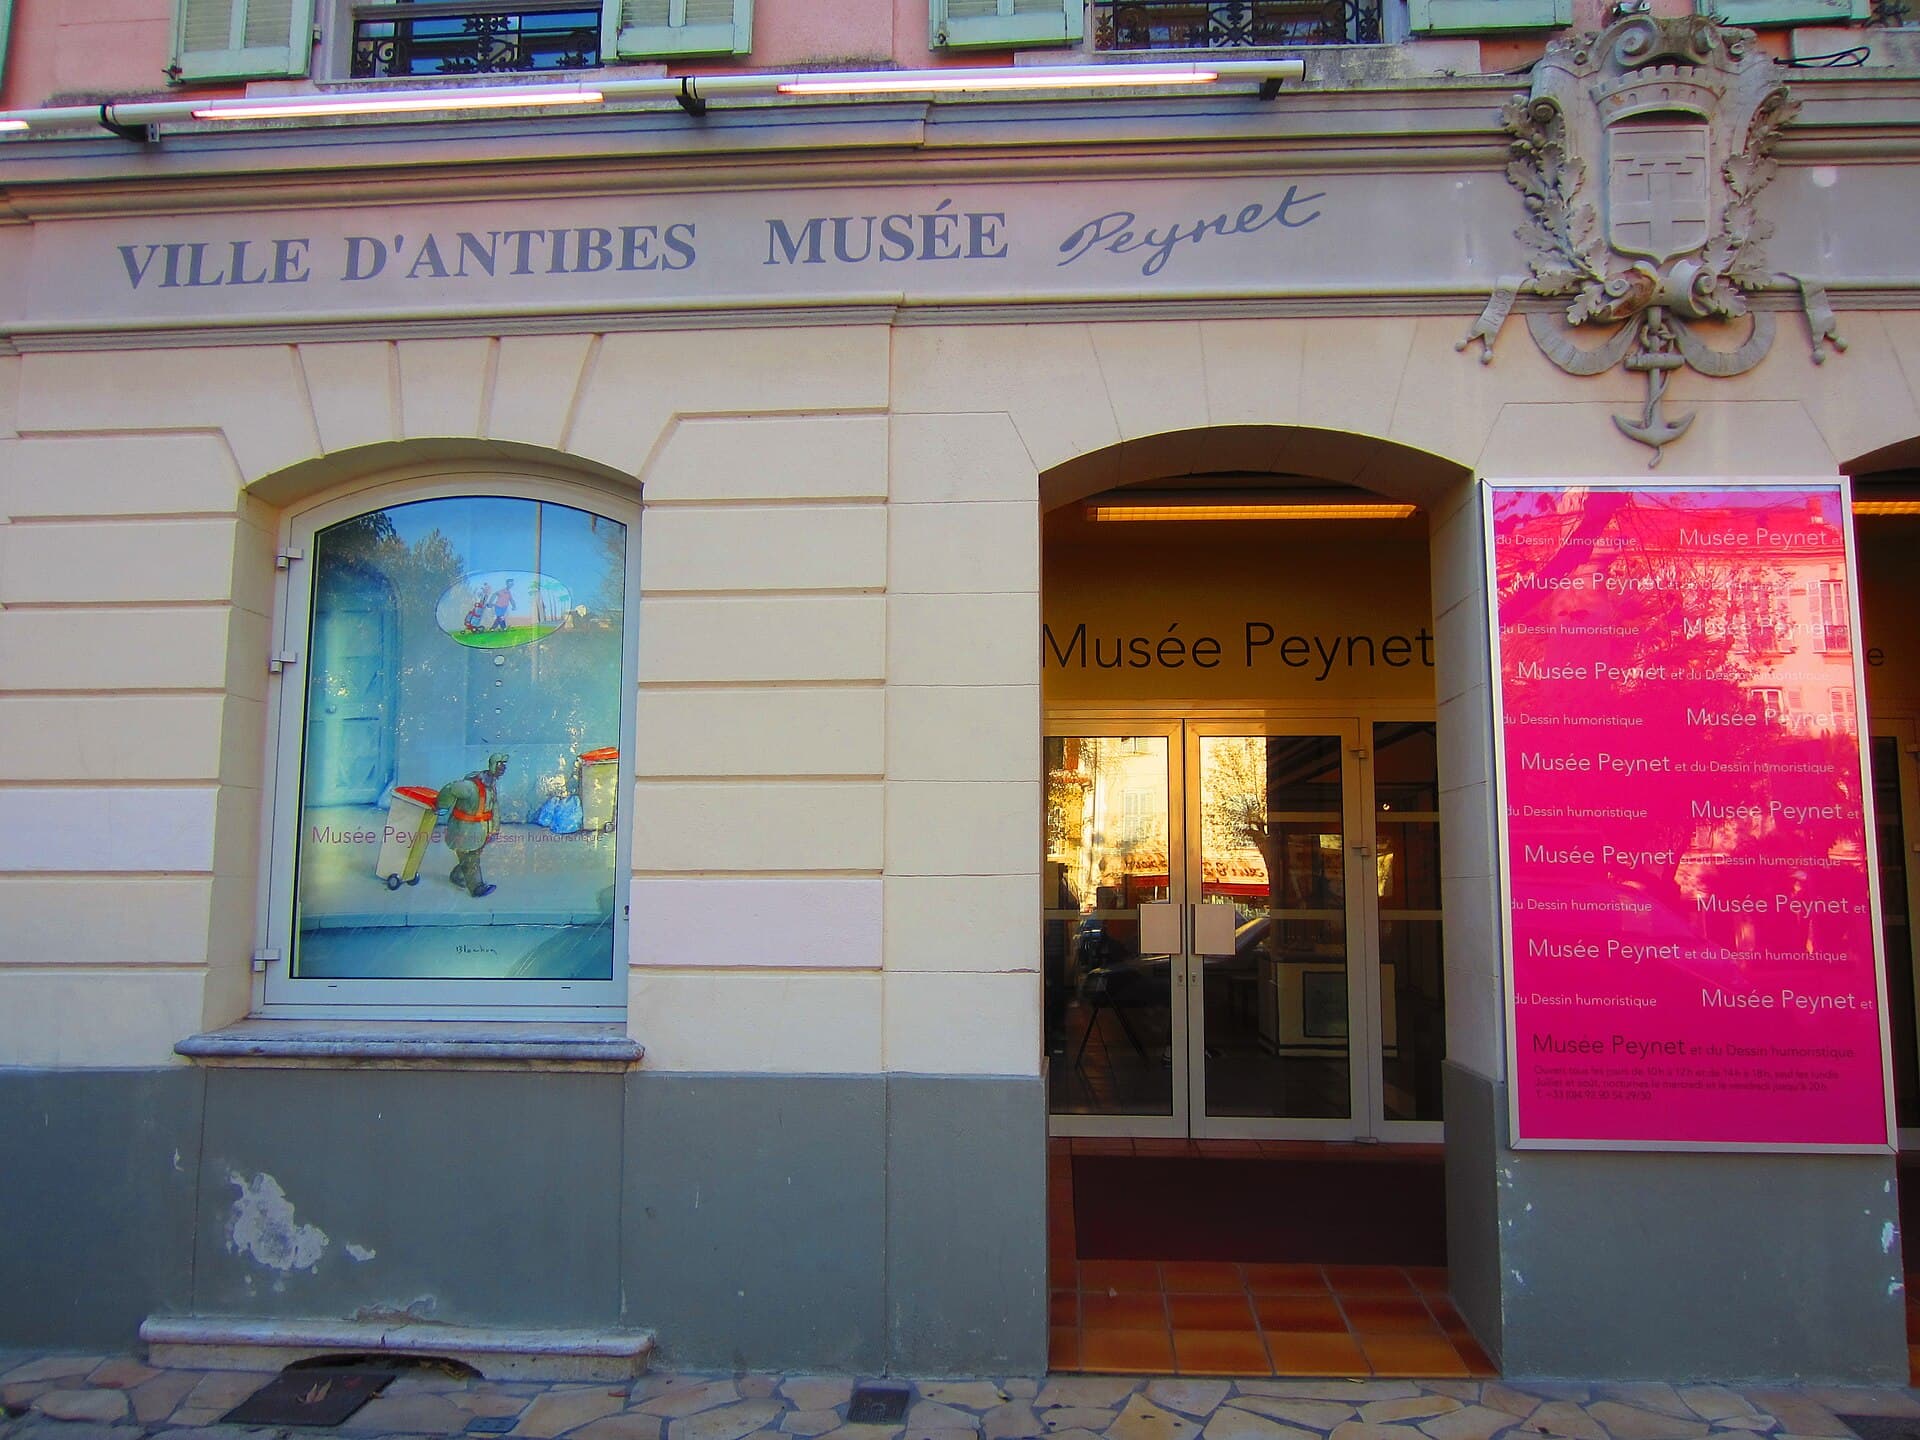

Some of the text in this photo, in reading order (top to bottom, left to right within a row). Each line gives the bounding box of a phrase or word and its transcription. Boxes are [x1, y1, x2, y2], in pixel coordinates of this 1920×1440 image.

[763, 184, 1327, 276] MUSÉE Peynet
[116, 223, 697, 290] VILLE D'ANTIBES
[1496, 535, 1512, 545] du
[1516, 535, 1554, 545] Dessin
[1680, 528, 1748, 545] Musée
[1757, 528, 1826, 550] Peynet
[1516, 572, 1585, 590] Musée
[1592, 572, 1664, 595] Peynet
[1517, 624, 1556, 634] Dessin
[1560, 624, 1639, 637] humoristique
[1042, 622, 1435, 681] Musée Peynet
[1518, 661, 1587, 680] Musée
[1595, 661, 1666, 685] Peynet
[1520, 714, 1560, 725] Dessin
[1564, 714, 1643, 728] humoristique
[1687, 708, 1756, 726] Musée
[1765, 708, 1837, 731] Peynet
[1521, 752, 1834, 776] Musée Peynet et du Dessin humoristique
[1524, 806, 1563, 817] Dessin
[1567, 806, 1648, 820] humoristique
[1691, 800, 1859, 824] Musée Peynet et
[312, 825, 376, 844] Musée
[1525, 845, 1595, 863] Musée
[1602, 845, 1675, 869] Peynet
[1715, 854, 1755, 865] Dessin
[1759, 855, 1841, 868] humoristique
[1527, 899, 1568, 910] Dessin
[1571, 899, 1653, 913] humoristique
[1697, 894, 1867, 918] Musée Peynet et
[1528, 939, 1848, 963] Musée Peynet et du Dessin humoristique
[1531, 993, 1573, 1005] Dessin
[1575, 993, 1657, 1008] humoristique
[1702, 988, 1873, 1014] Musée Peynet et
[1533, 1033, 1604, 1054] Musée
[1612, 1034, 1685, 1060] Peynet
